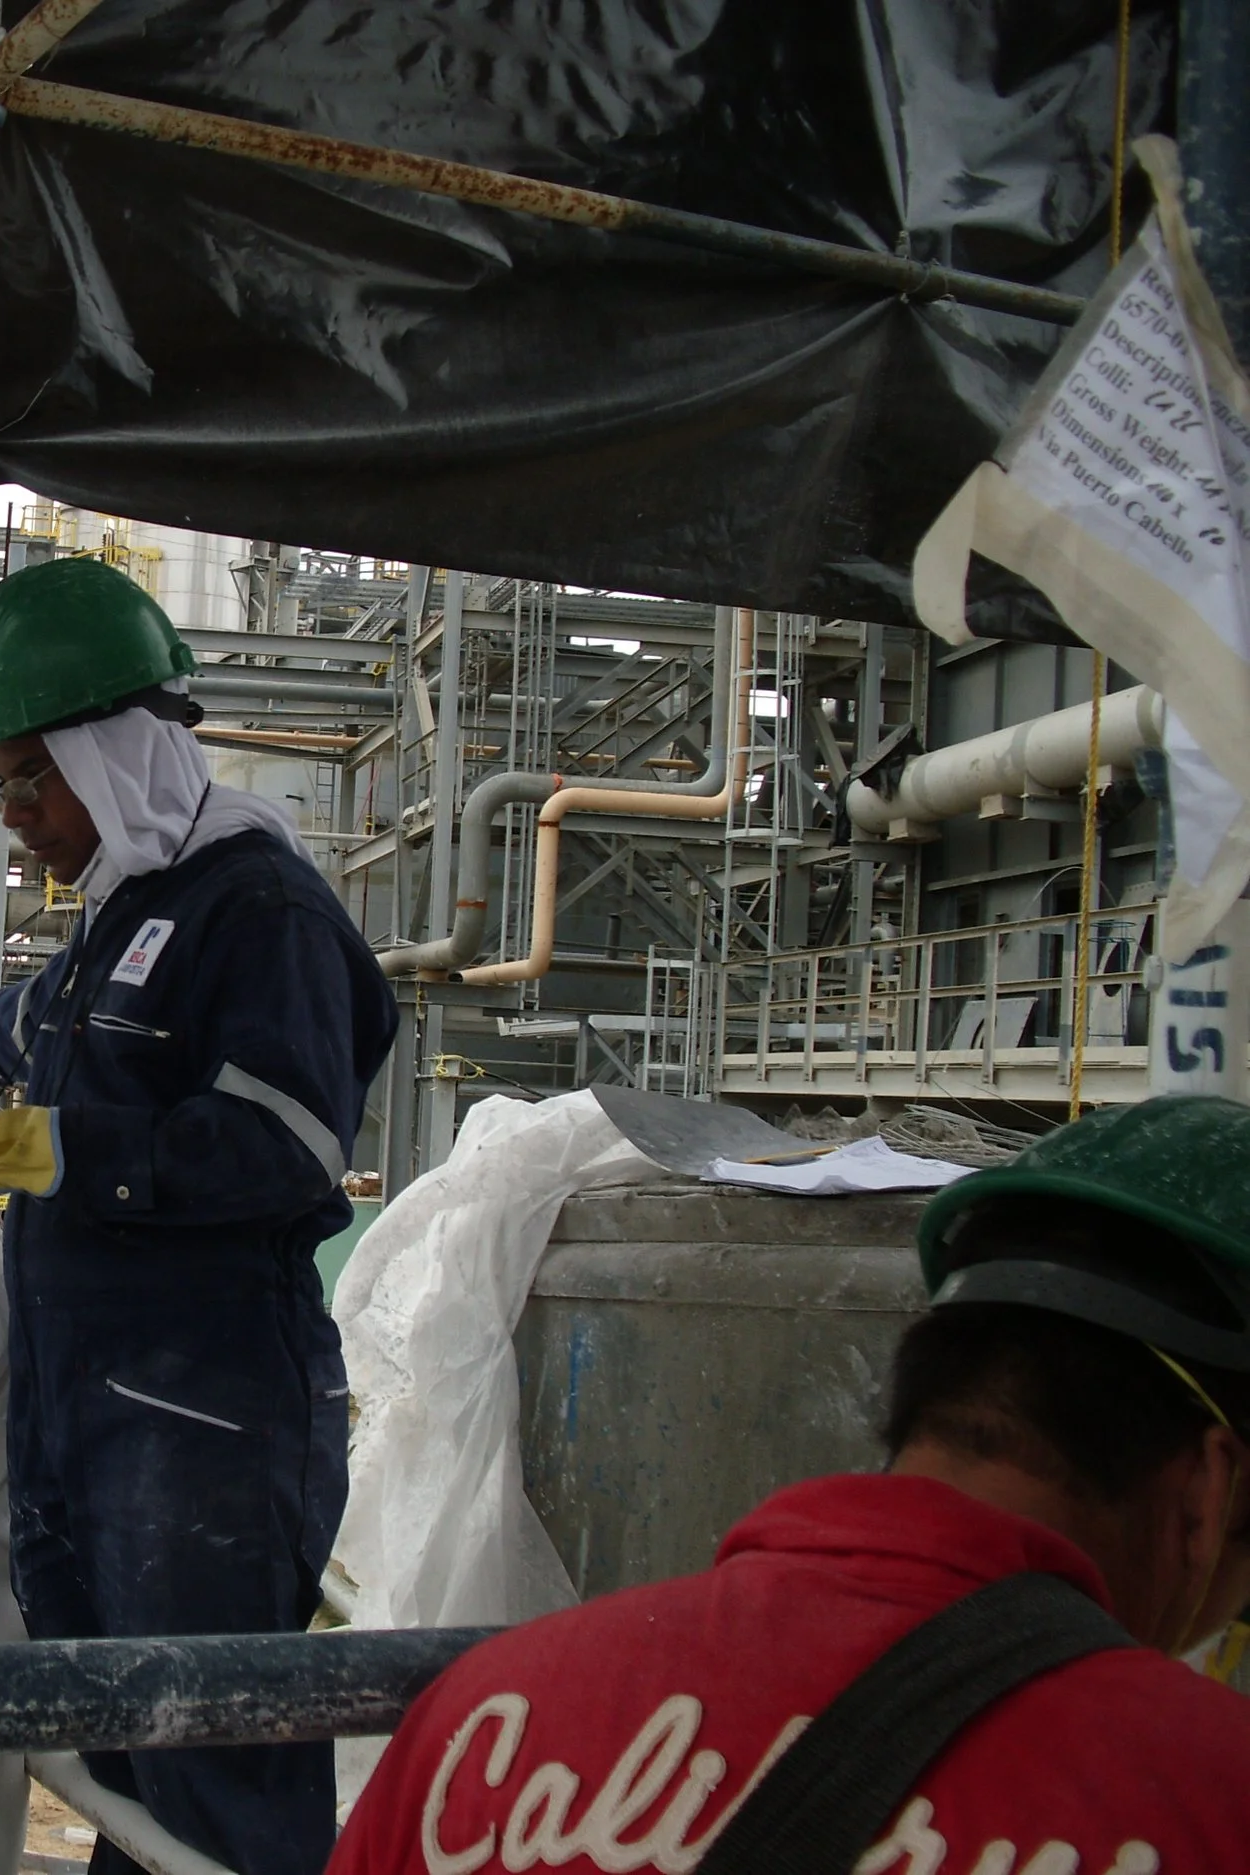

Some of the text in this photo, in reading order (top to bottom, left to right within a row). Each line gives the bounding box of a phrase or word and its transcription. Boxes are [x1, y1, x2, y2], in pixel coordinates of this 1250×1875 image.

[1085, 346, 1133, 395] Colli:
[1051, 398, 1147, 486] Dimensions
[1068, 372, 1195, 482] Gross Weight:
[1061, 450, 1120, 507] Puerto
[1124, 500, 1193, 563] Cabello
